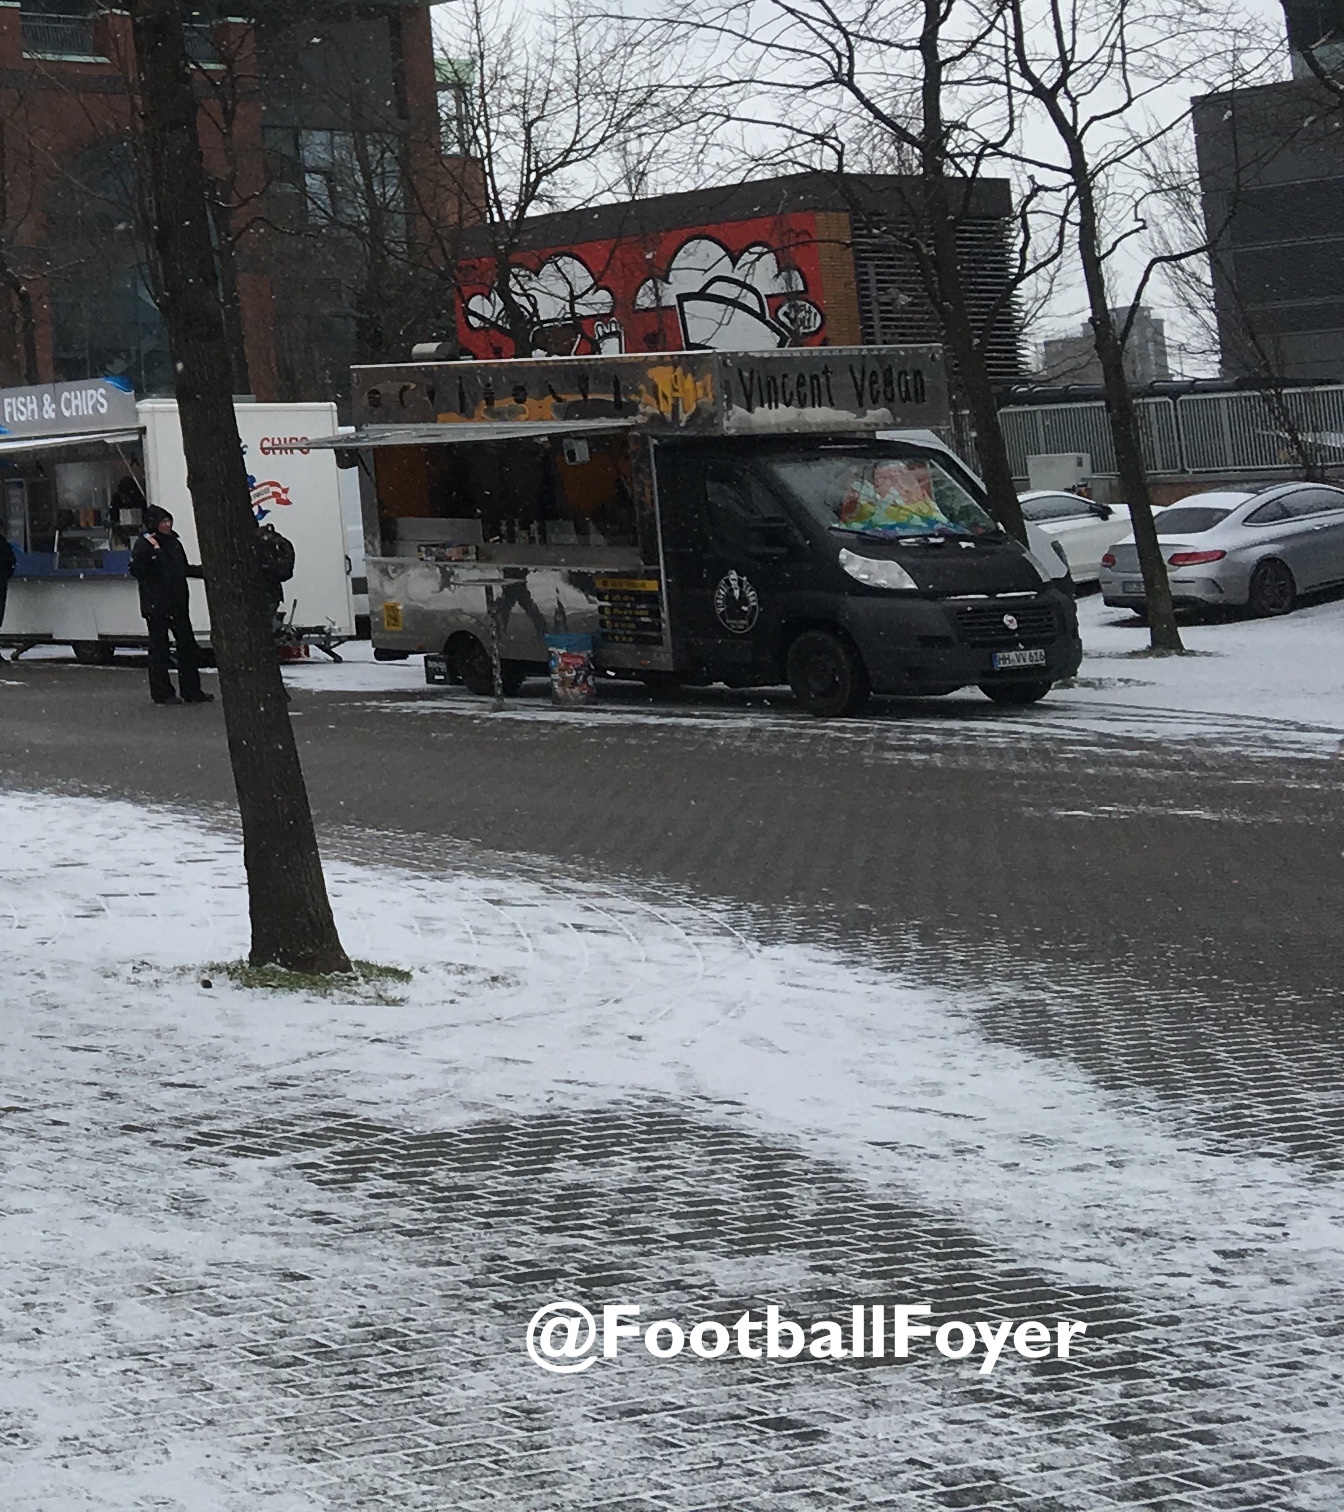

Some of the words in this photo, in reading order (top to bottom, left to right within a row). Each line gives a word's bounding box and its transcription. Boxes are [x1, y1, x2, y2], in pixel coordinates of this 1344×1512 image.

[3, 395, 39, 423] FISH
[42, 393, 56, 419] &
[60, 387, 109, 417] CHIPS
[737, 364, 836, 414] Vincent
[259, 436, 311, 456] CHIPS
